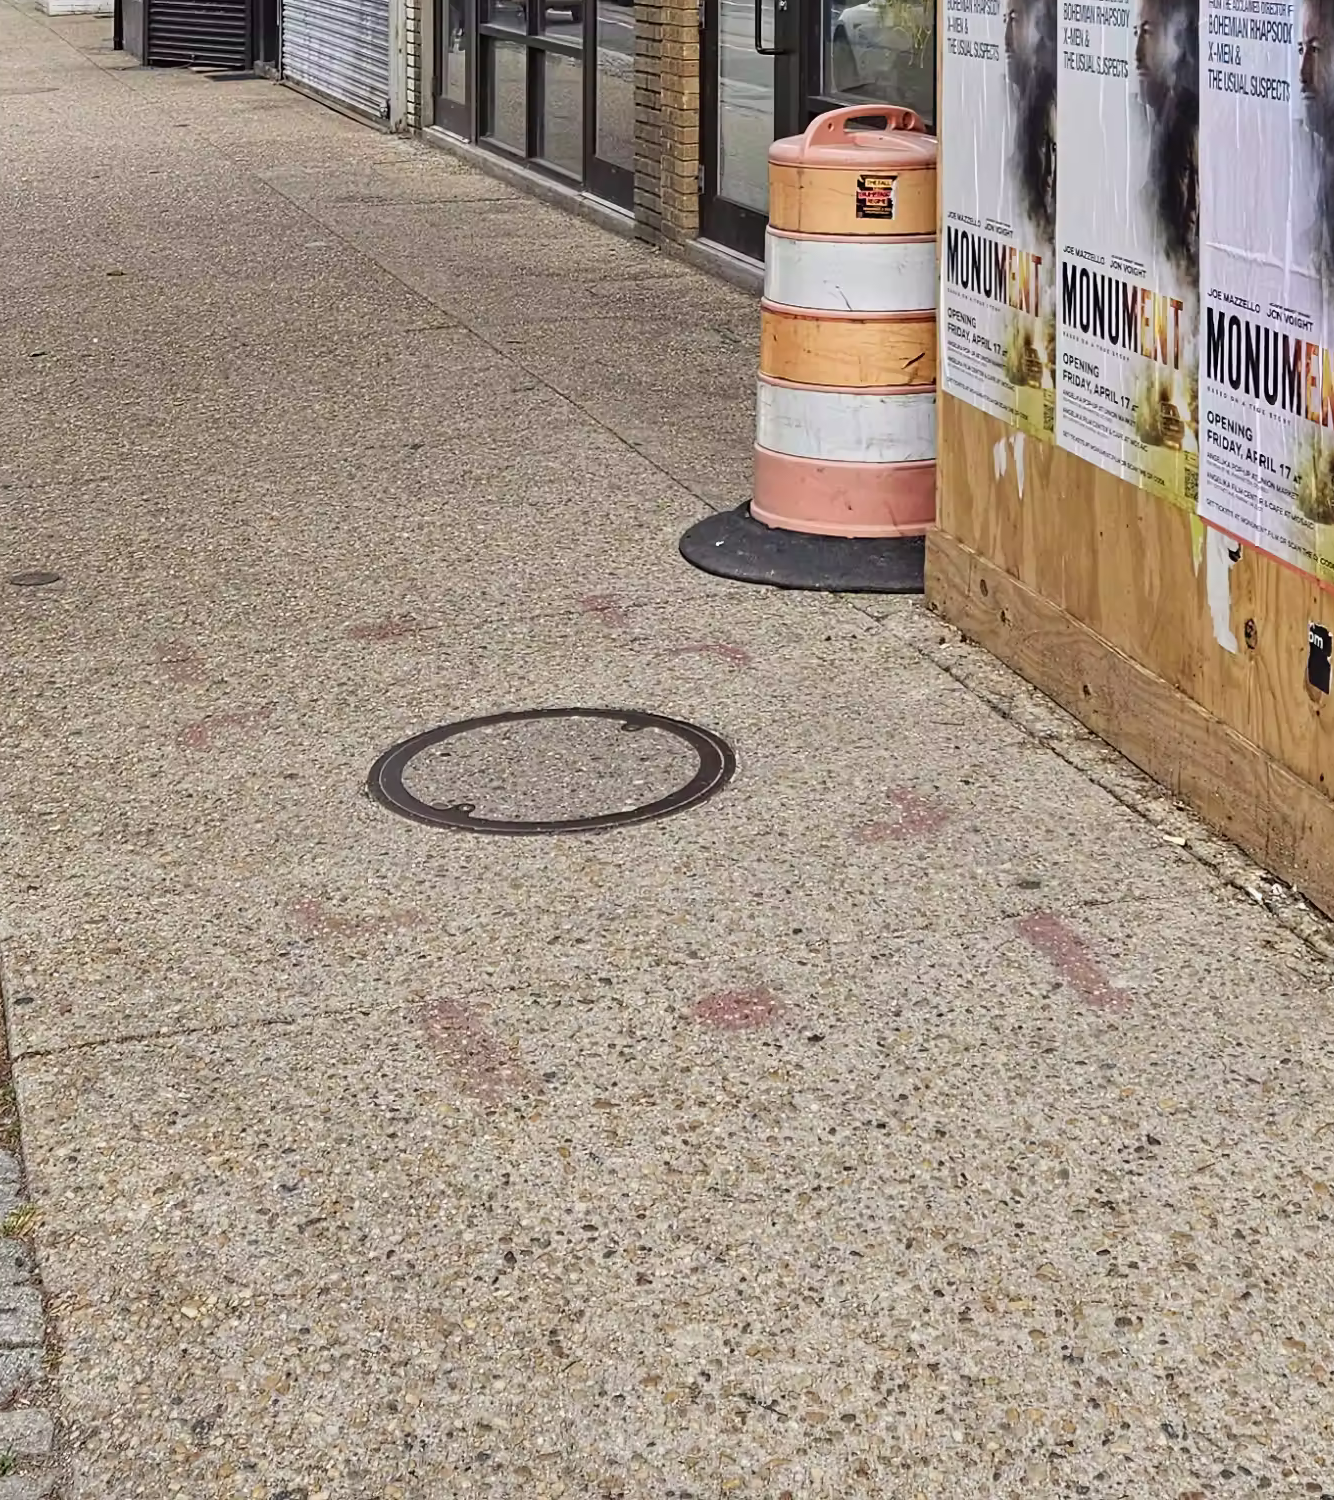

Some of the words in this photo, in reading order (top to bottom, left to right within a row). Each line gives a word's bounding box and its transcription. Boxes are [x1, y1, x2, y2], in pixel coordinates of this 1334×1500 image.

[947, 226, 1042, 317] MONUMENT
[947, 307, 976, 328] OPENING
[1062, 261, 1184, 370] MONUMENT
[1062, 353, 1100, 378] OPENING
[1207, 410, 1253, 442] OPENING
